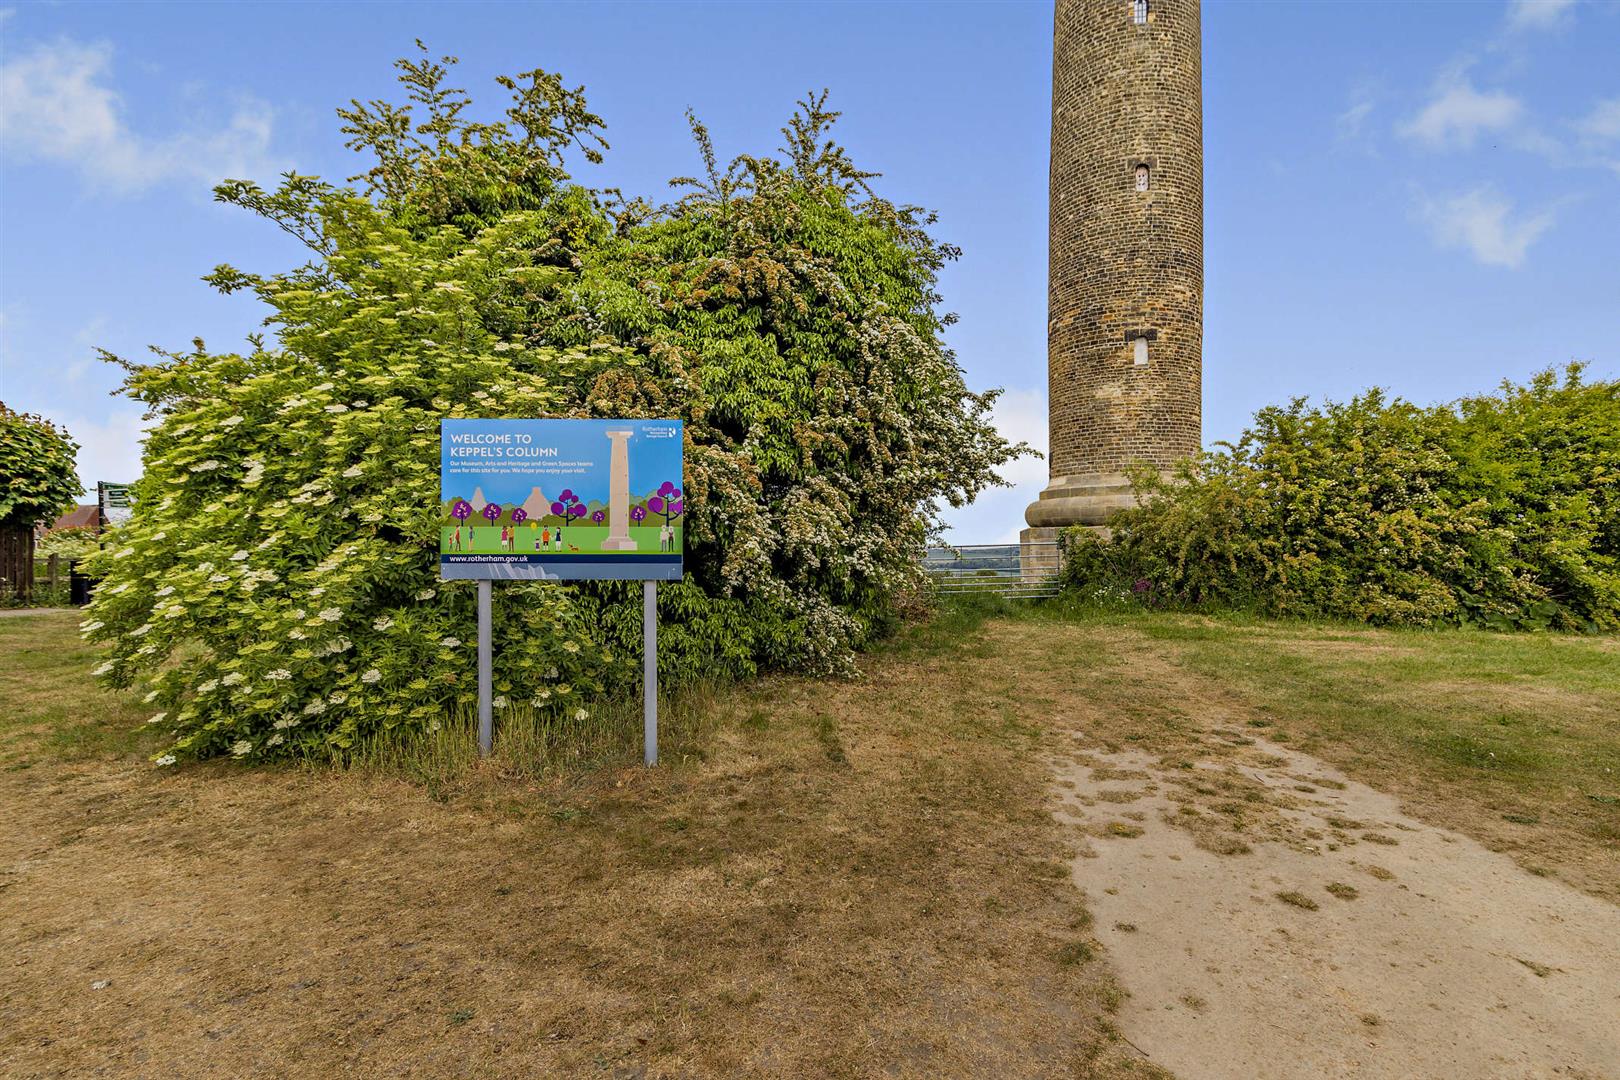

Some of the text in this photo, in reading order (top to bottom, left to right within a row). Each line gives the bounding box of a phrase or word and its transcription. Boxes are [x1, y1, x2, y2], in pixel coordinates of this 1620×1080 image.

[450, 433, 532, 444] WELCOME TO
[450, 447, 558, 457] KEPPEL'S COLUMN
[508, 460, 530, 468] Heritage
[449, 555, 529, 564] www.rotherham.gov.uk
